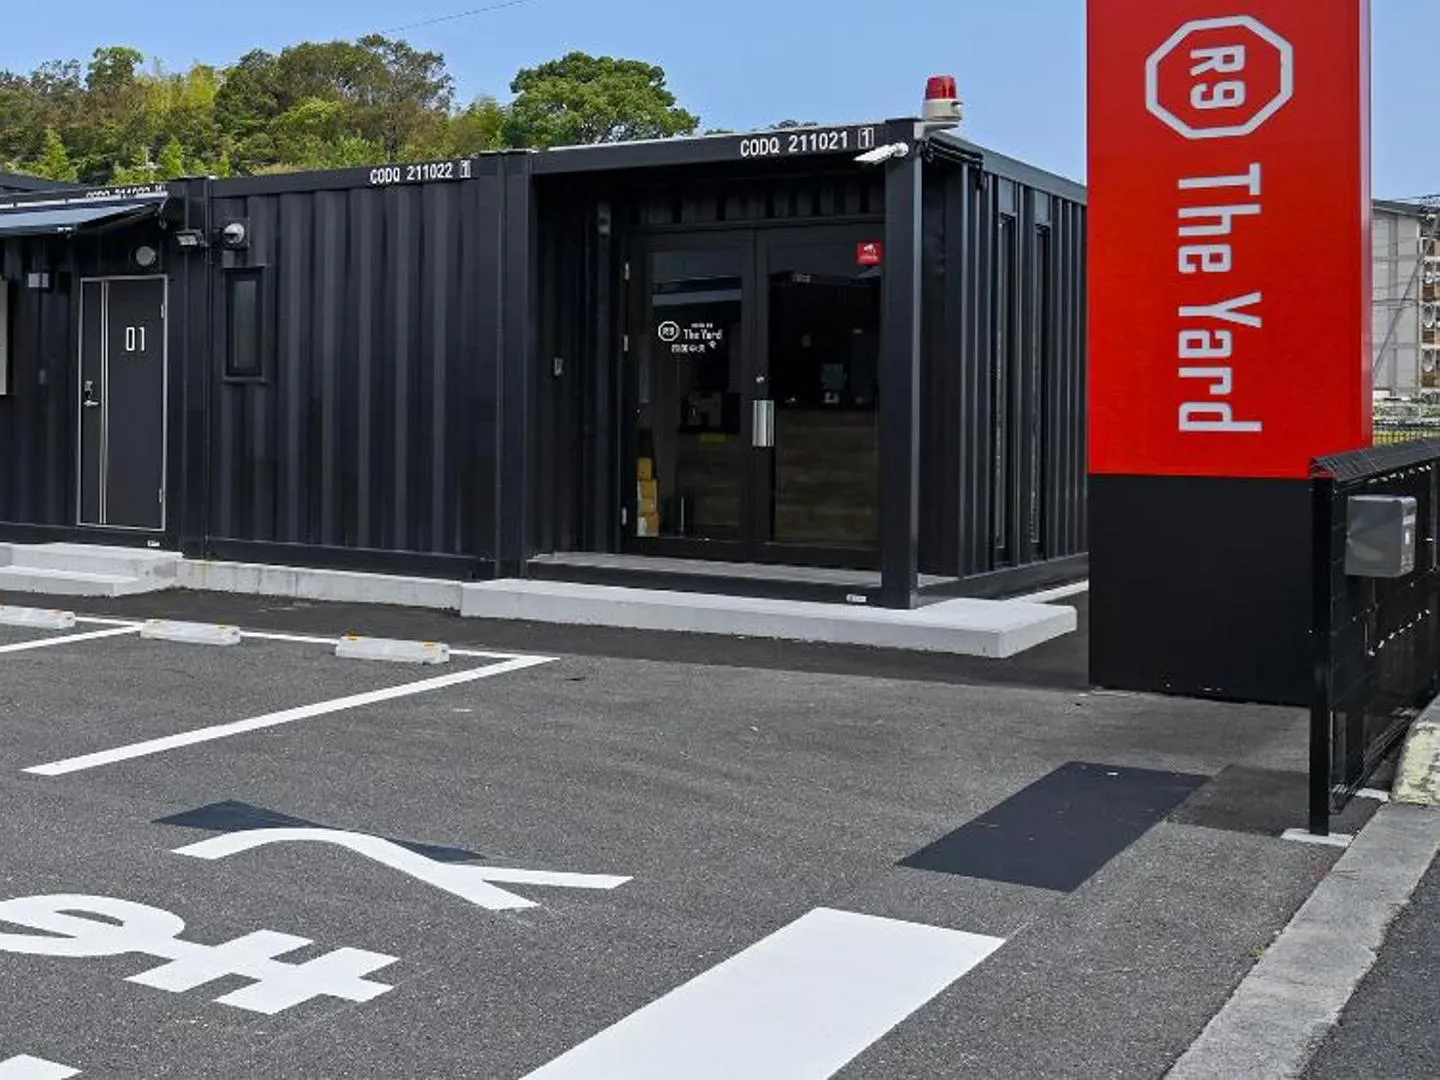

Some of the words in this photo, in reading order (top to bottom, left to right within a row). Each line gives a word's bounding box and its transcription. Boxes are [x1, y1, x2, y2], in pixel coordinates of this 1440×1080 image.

[1189, 44, 1246, 111] R9
[788, 131, 848, 153] 211021
[406, 162, 454, 181] 211022
[1177, 162, 1262, 274] The
[124, 325, 147, 352] 01
[1177, 291, 1262, 433] Yard
